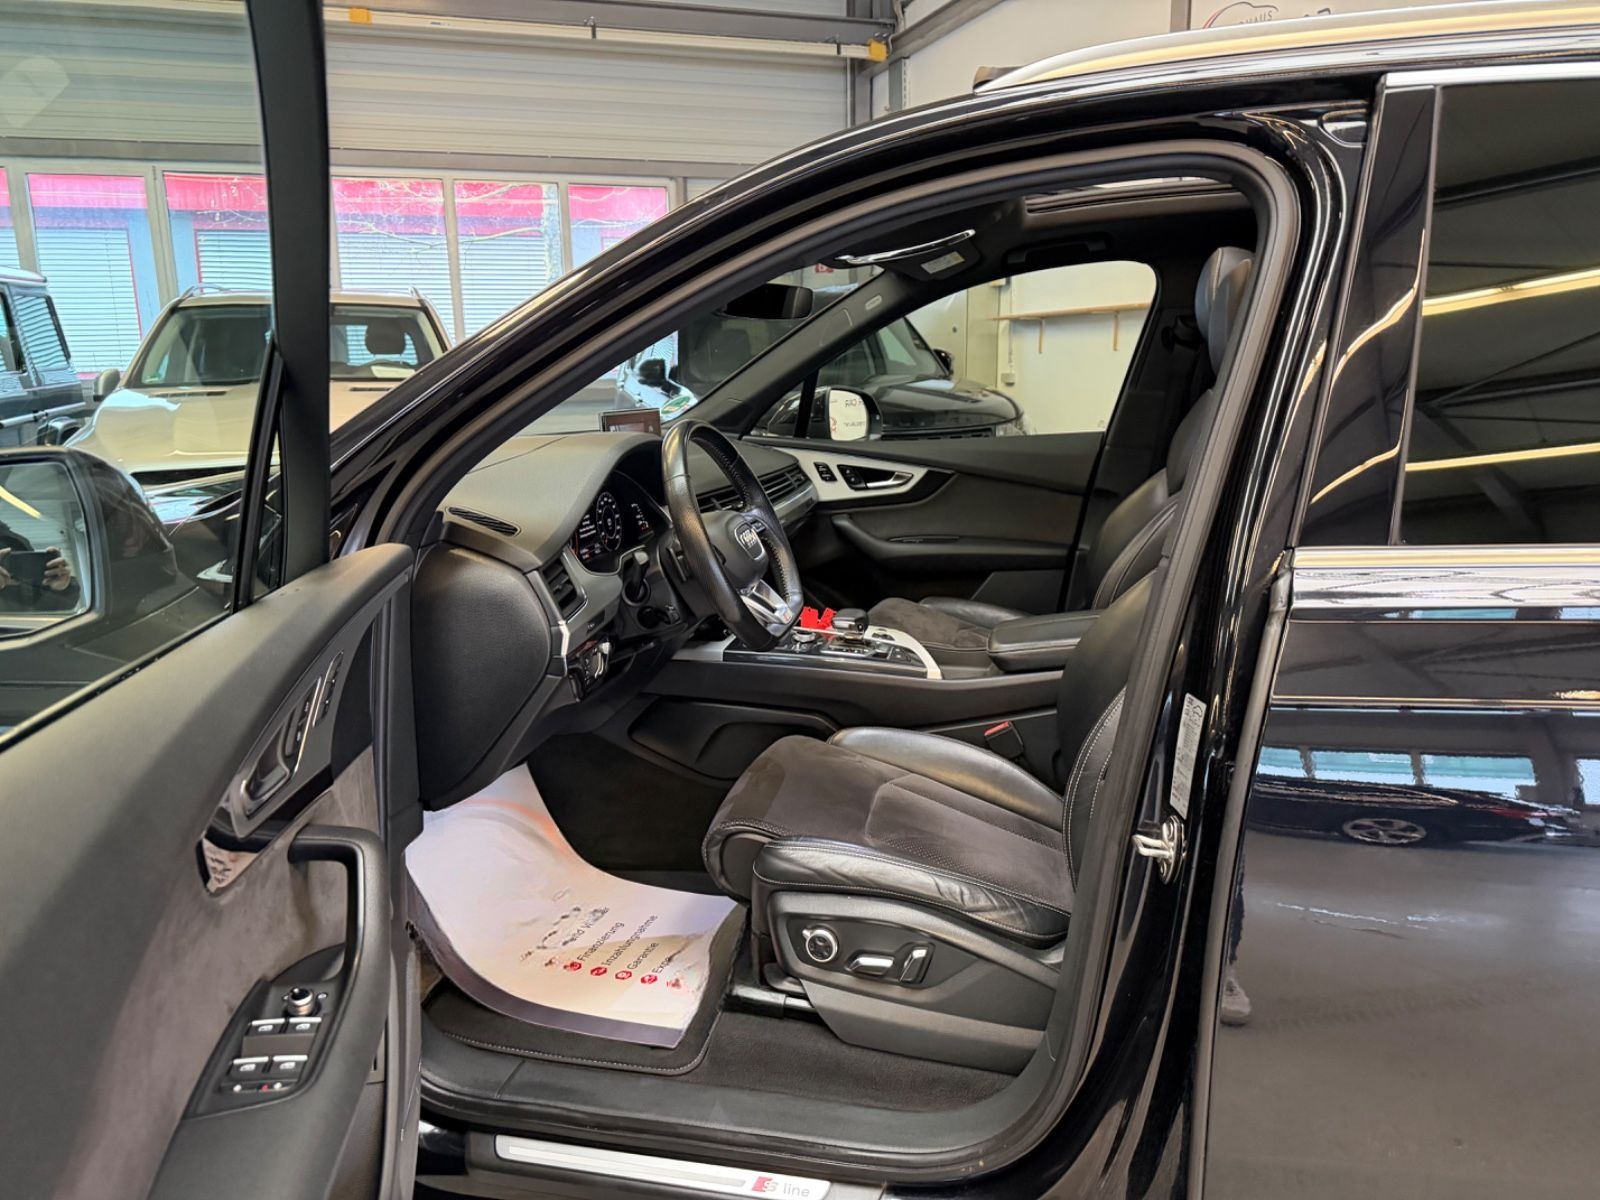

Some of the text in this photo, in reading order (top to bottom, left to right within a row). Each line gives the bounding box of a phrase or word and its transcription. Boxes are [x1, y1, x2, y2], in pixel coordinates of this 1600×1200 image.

[576, 921, 625, 961] Finanzierung
[626, 942, 659, 969] Garantie
[783, 1182, 810, 1197] line
